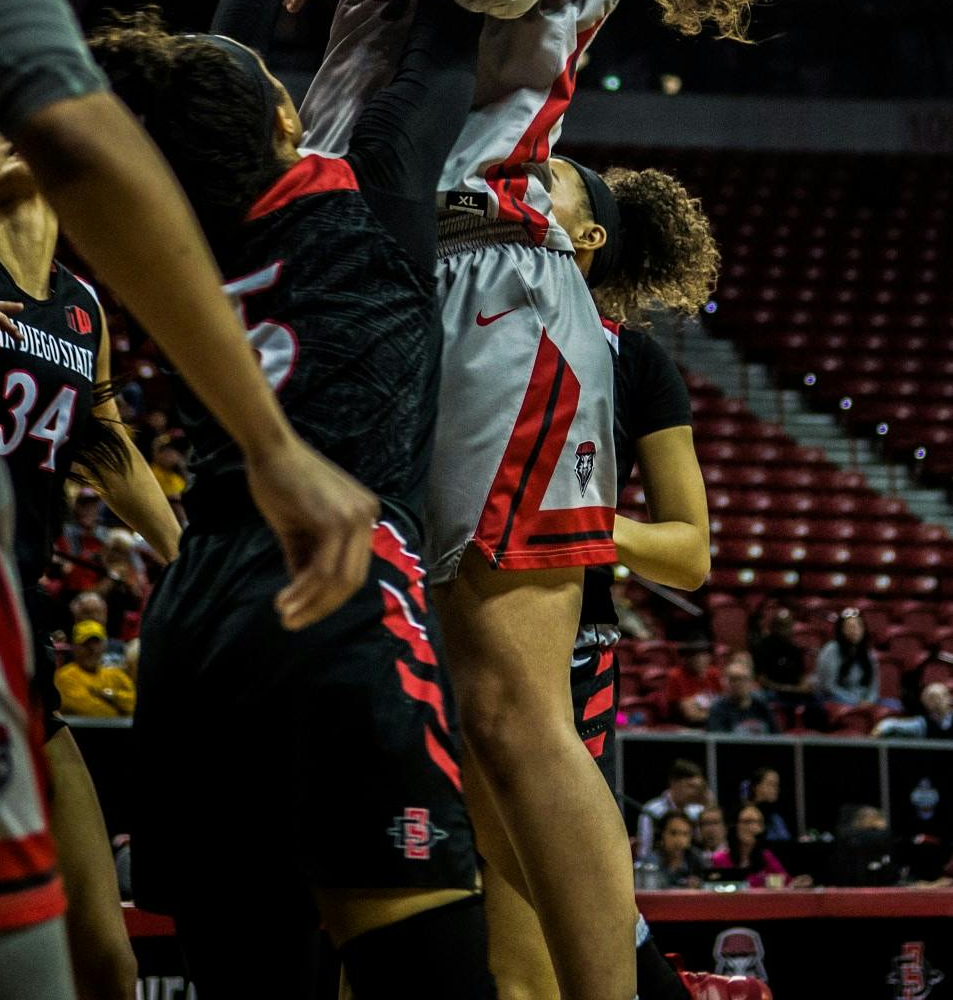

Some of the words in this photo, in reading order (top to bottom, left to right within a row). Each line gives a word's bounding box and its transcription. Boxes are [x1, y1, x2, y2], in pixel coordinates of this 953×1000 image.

[457, 195, 479, 207] XL
[16, 320, 61, 366] DIEGO
[58, 337, 94, 383] STATE
